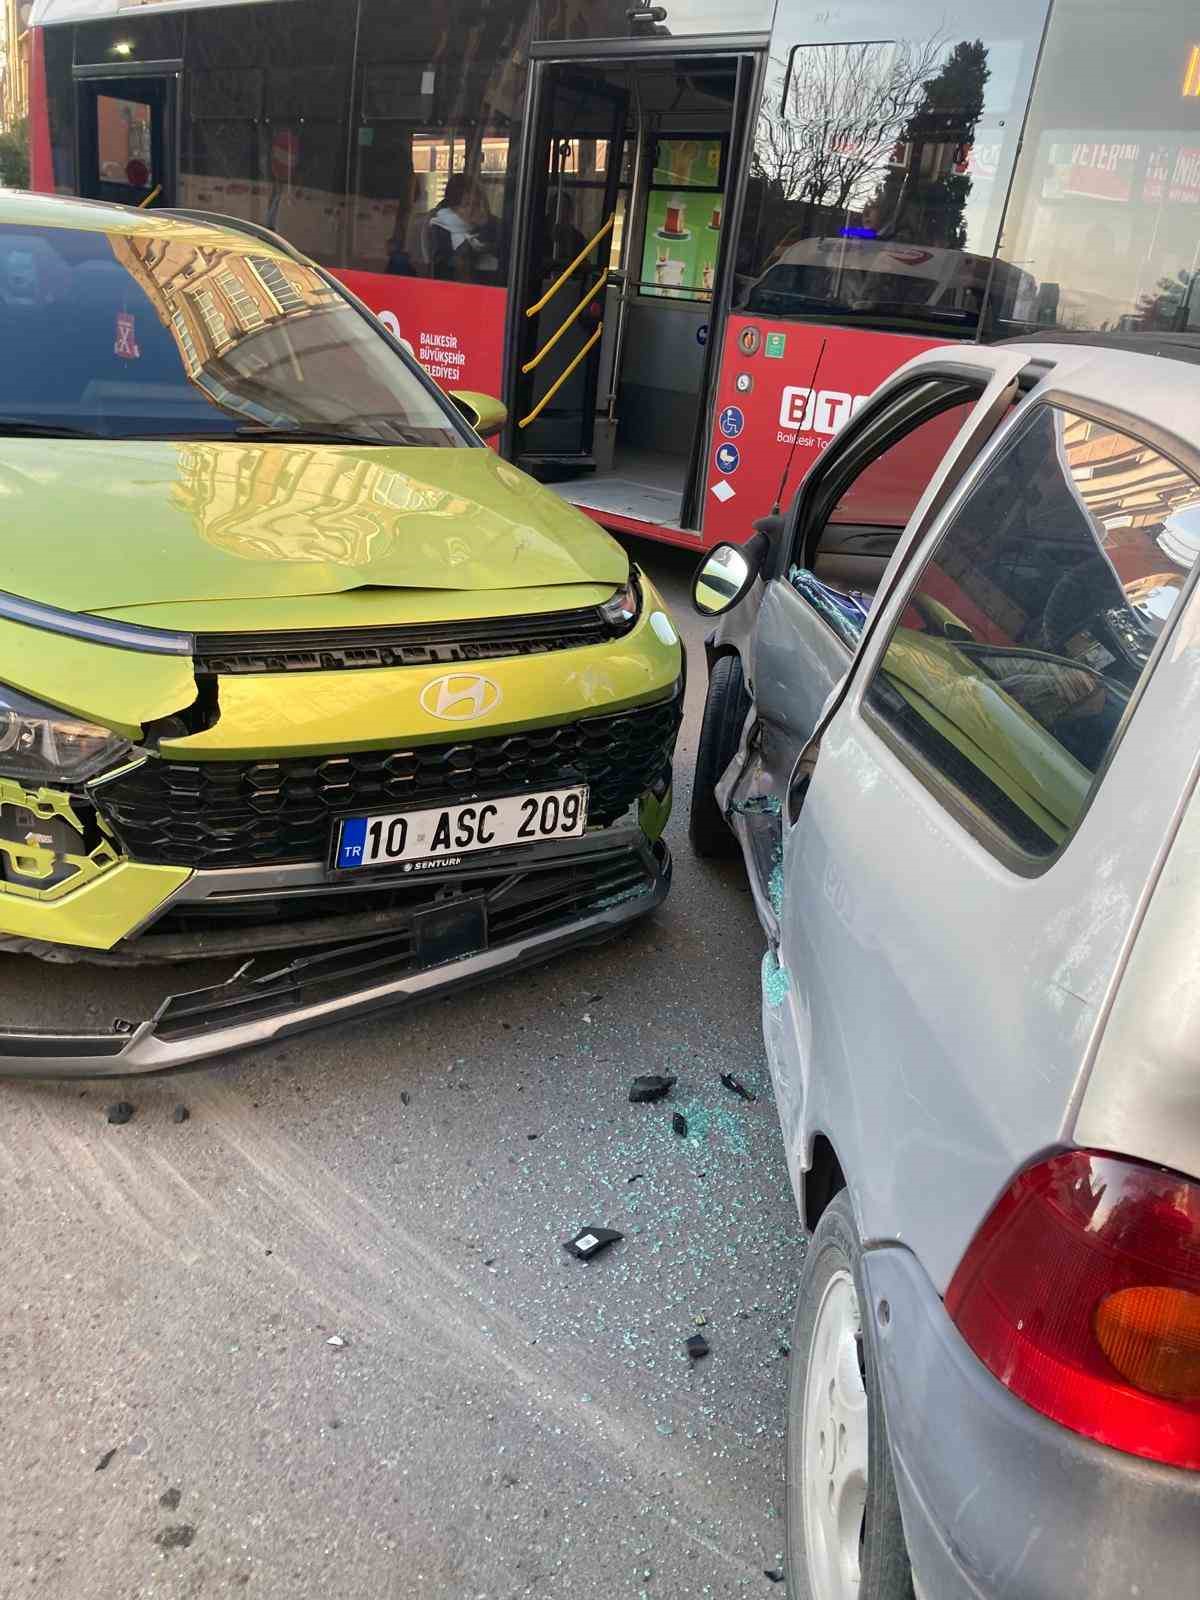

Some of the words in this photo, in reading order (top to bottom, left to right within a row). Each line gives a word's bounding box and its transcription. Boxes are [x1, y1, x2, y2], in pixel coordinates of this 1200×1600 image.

[420, 332, 458, 349] BALIKESİR
[419, 346, 466, 366] BÜYÜKŞEHİR
[423, 363, 460, 381] ELEDİYESİ
[783, 388, 850, 433] BT
[816, 437, 830, 449] To
[344, 844, 362, 858] TR
[369, 817, 409, 859] 10
[430, 804, 498, 852] ASC
[517, 793, 581, 838] 209
